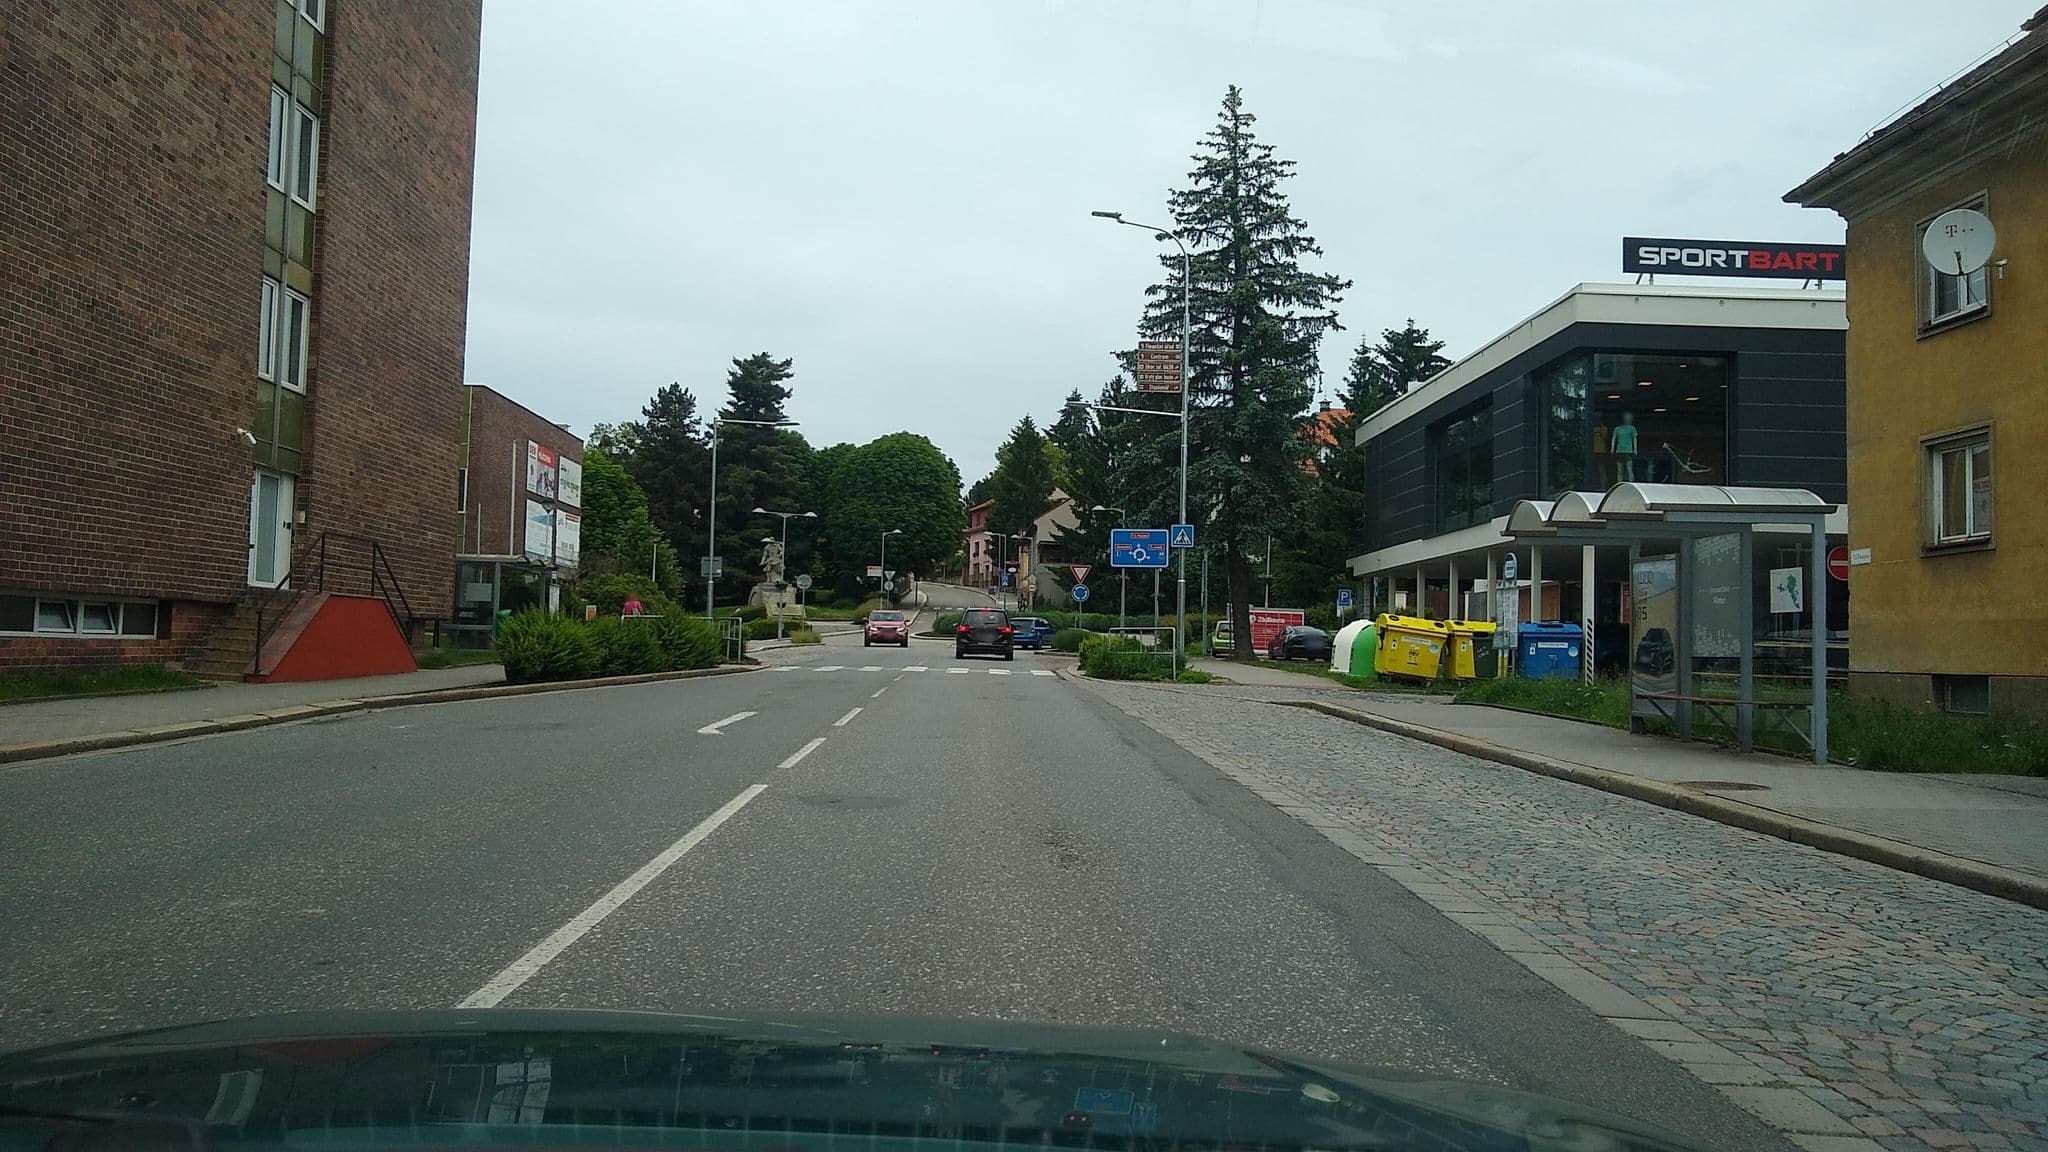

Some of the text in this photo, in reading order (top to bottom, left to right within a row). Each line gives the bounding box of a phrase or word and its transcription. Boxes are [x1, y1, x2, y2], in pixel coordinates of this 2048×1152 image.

[1946, 225, 1957, 237] T
[1639, 246, 1839, 271] SPORTBART
[1341, 591, 1349, 601] P
